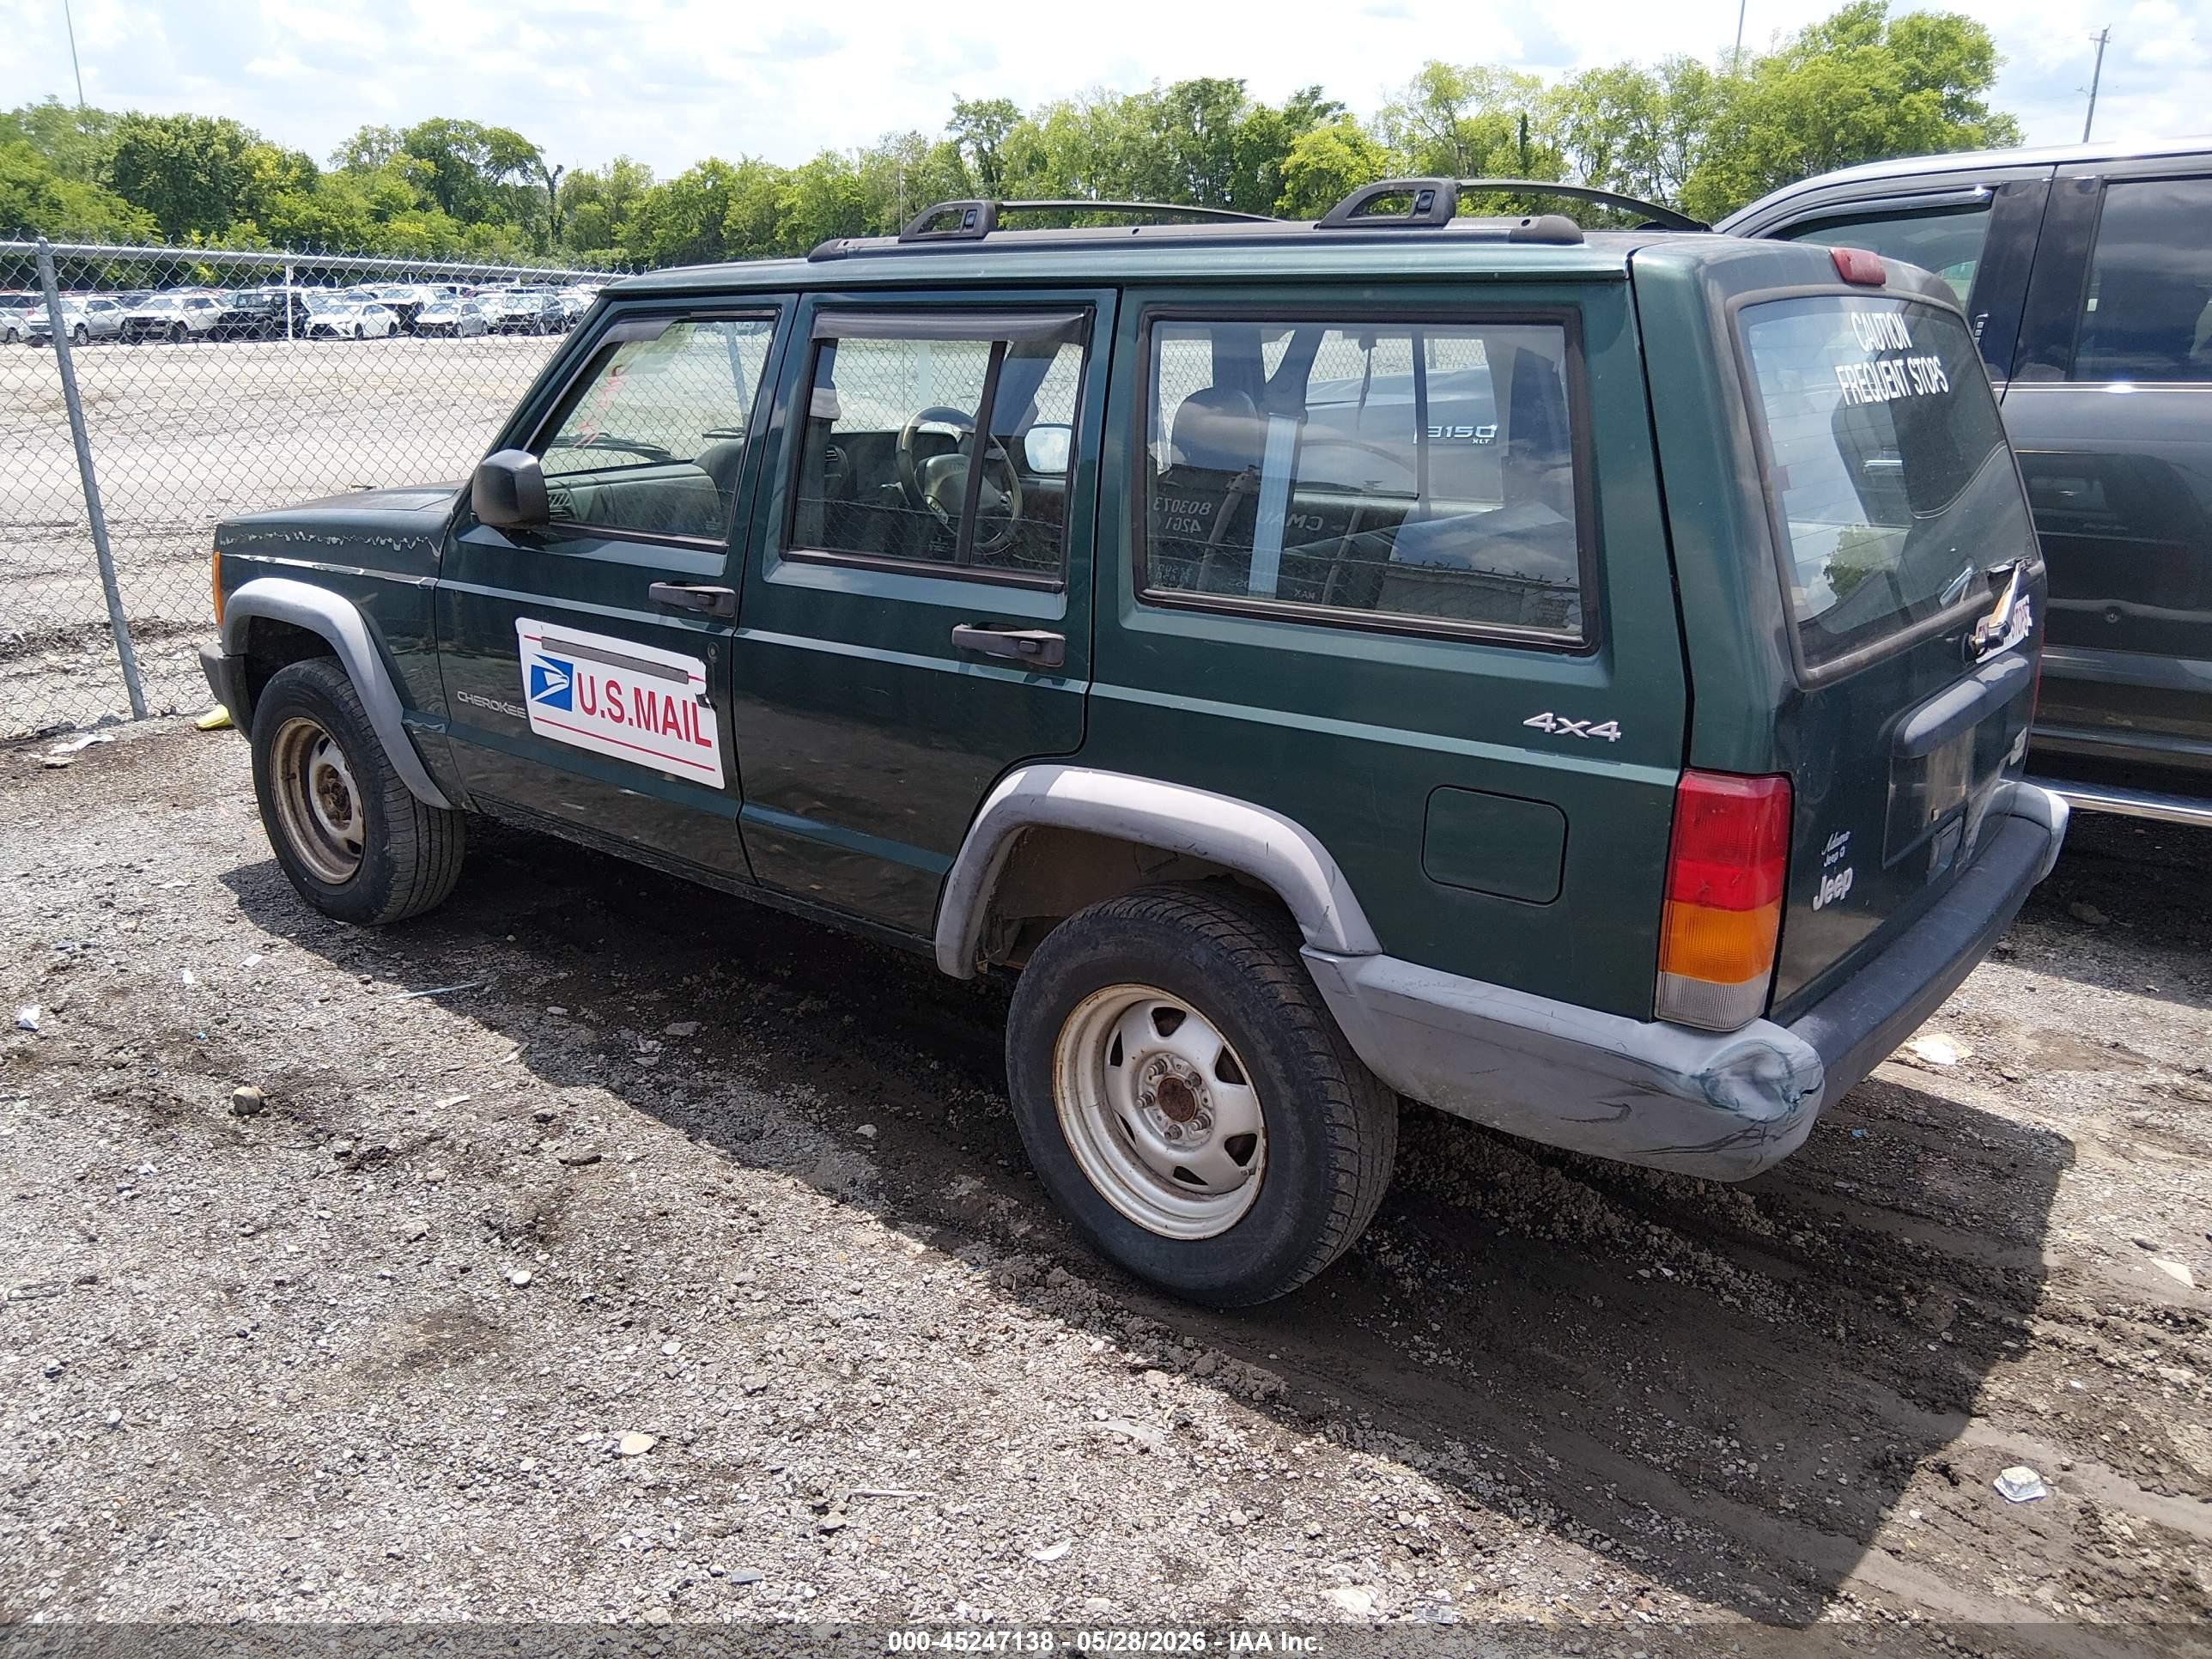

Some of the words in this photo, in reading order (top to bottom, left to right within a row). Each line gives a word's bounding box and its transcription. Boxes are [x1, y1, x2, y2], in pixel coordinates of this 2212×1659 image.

[1850, 312, 1913, 352] CAUTION
[1834, 359, 1912, 406] FREQUENT
[1906, 356, 1949, 396] STOPS
[457, 690, 528, 720] CHEROKEE
[577, 672, 713, 749] U.S.MAIL
[1813, 866, 1853, 911] Jeep
